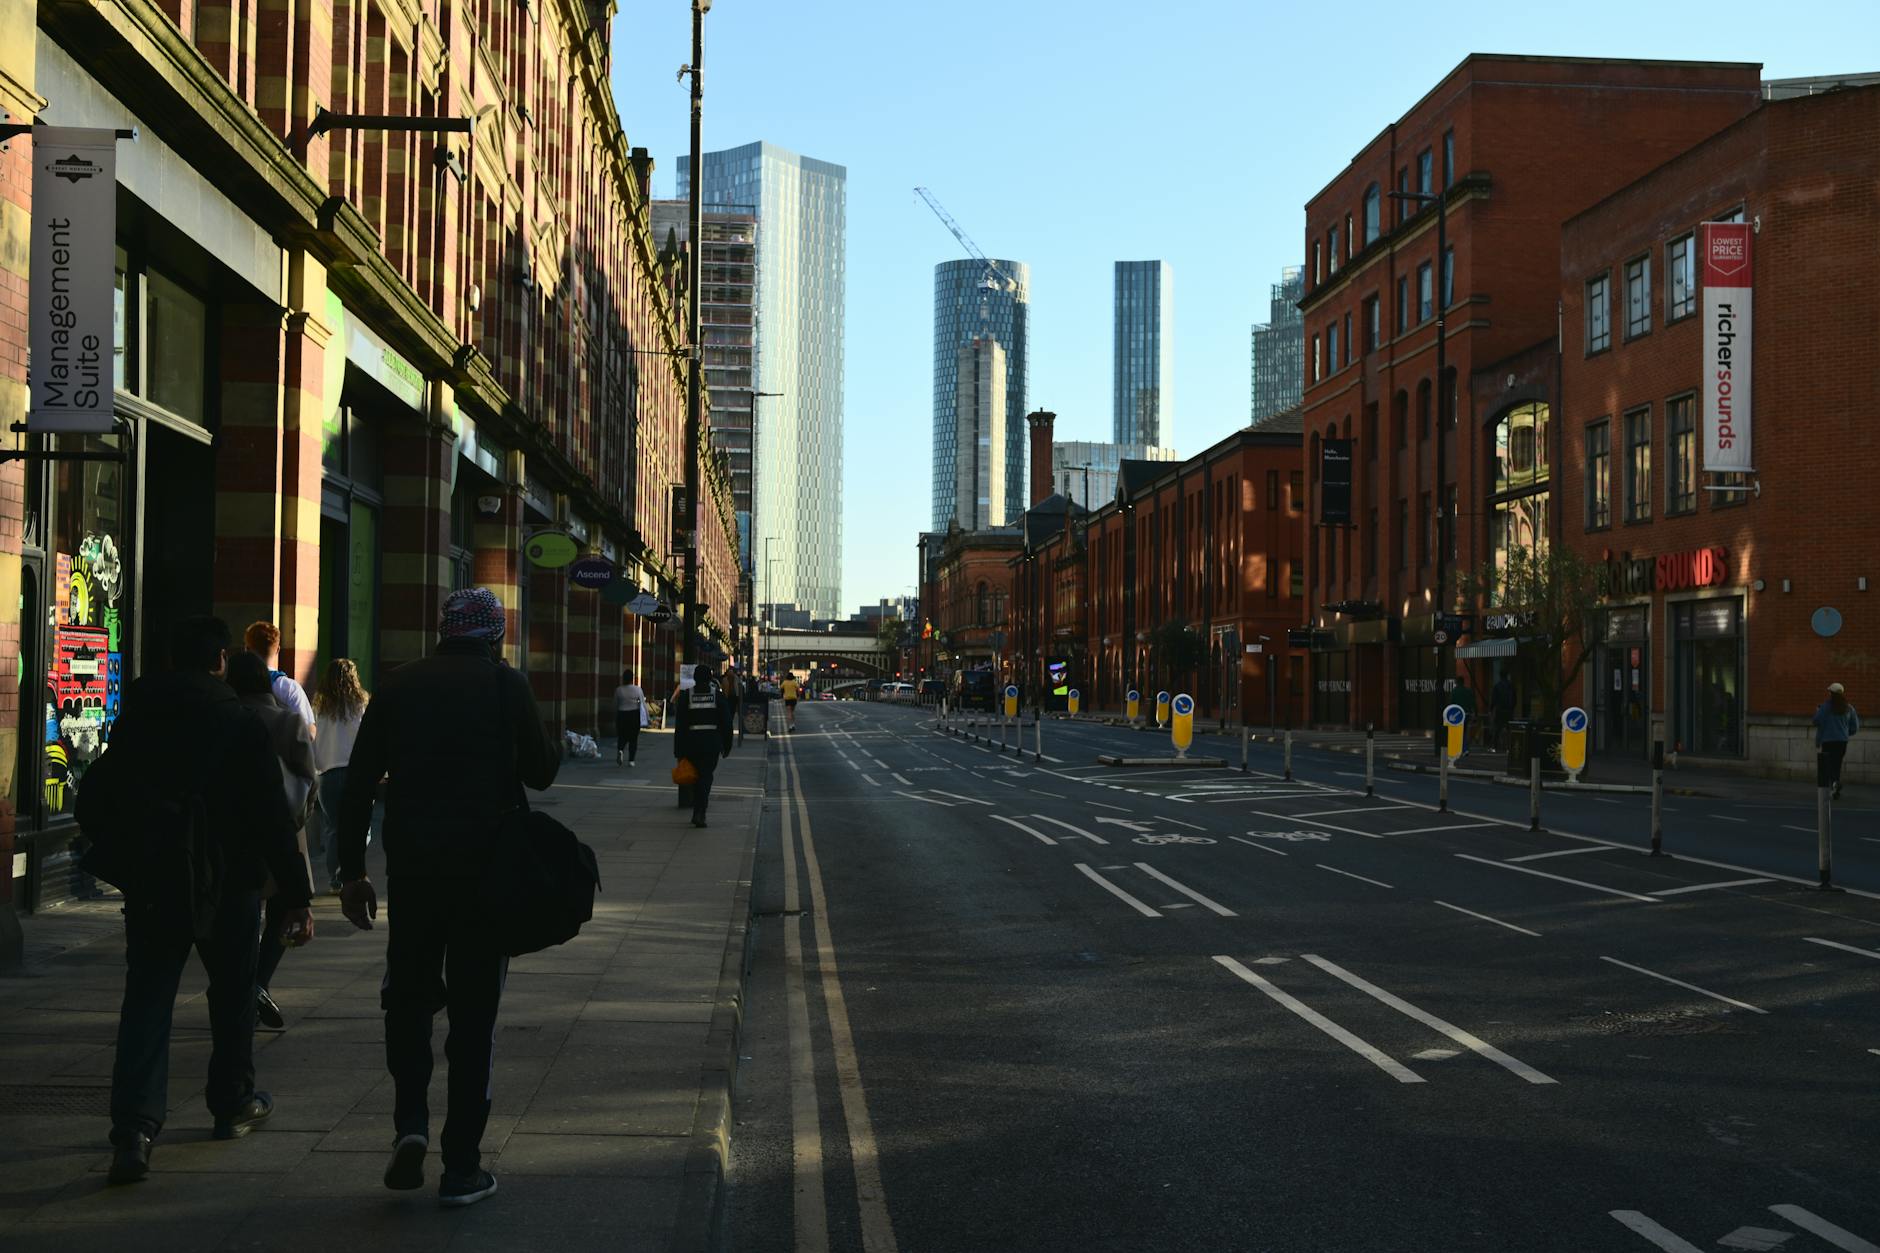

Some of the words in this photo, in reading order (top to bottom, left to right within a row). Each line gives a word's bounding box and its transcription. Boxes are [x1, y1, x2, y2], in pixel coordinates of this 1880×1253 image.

[1712, 246, 1743, 255] PRICE
[44, 218, 77, 408] Management
[74, 334, 100, 409] Suite
[576, 569, 610, 579] Ascend
